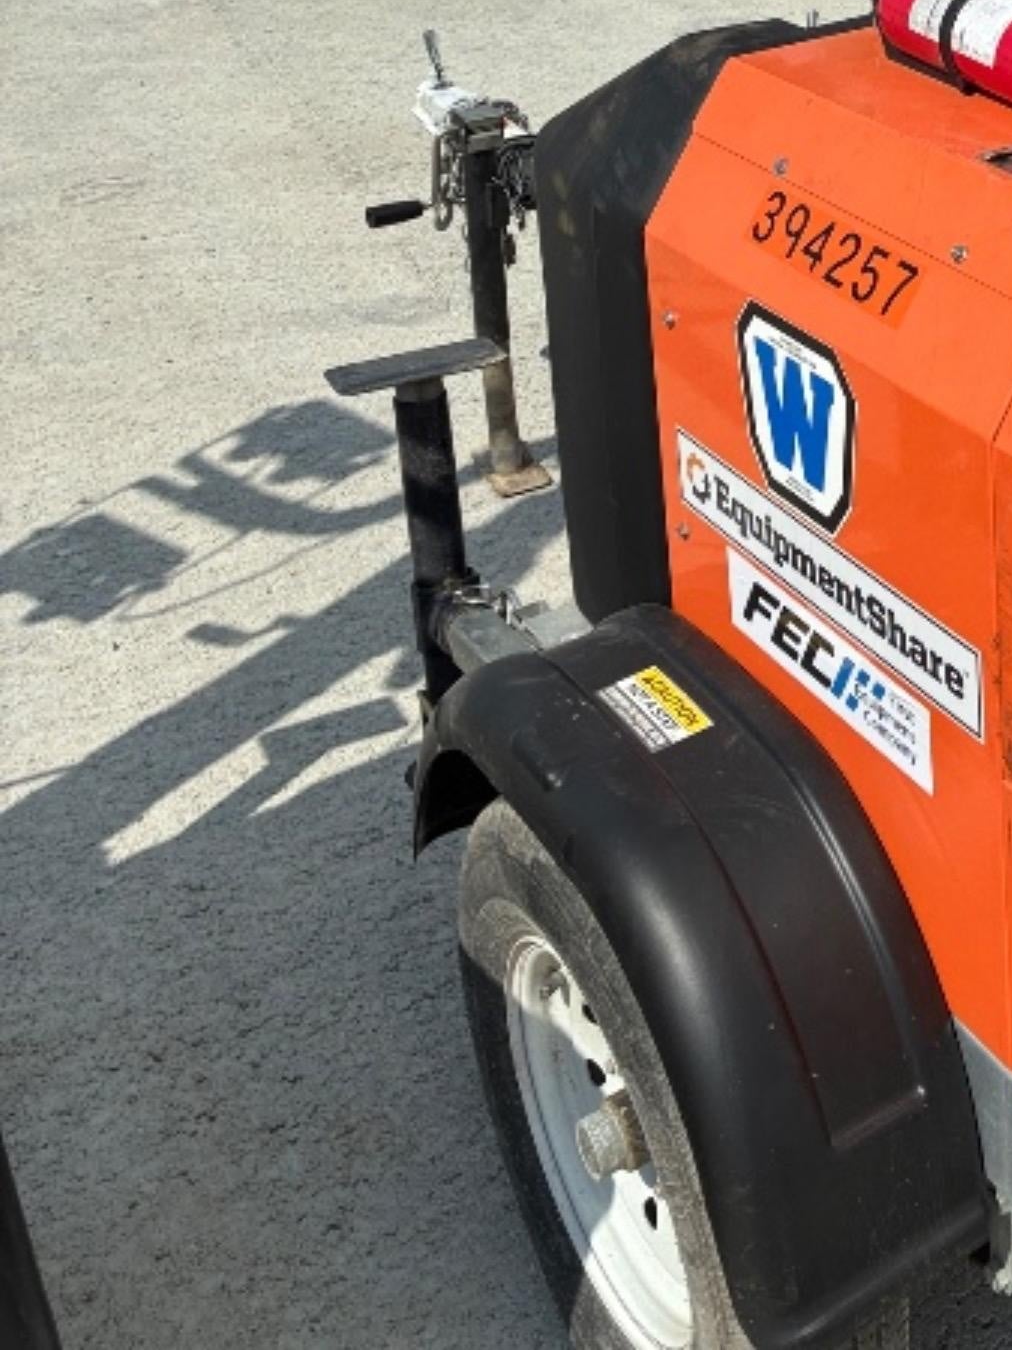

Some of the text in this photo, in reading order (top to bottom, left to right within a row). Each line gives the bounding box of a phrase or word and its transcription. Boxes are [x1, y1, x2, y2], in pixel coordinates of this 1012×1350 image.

[752, 191, 919, 316] 394257
[713, 473, 967, 700] EquipmentShare
[742, 581, 836, 690] FEC
